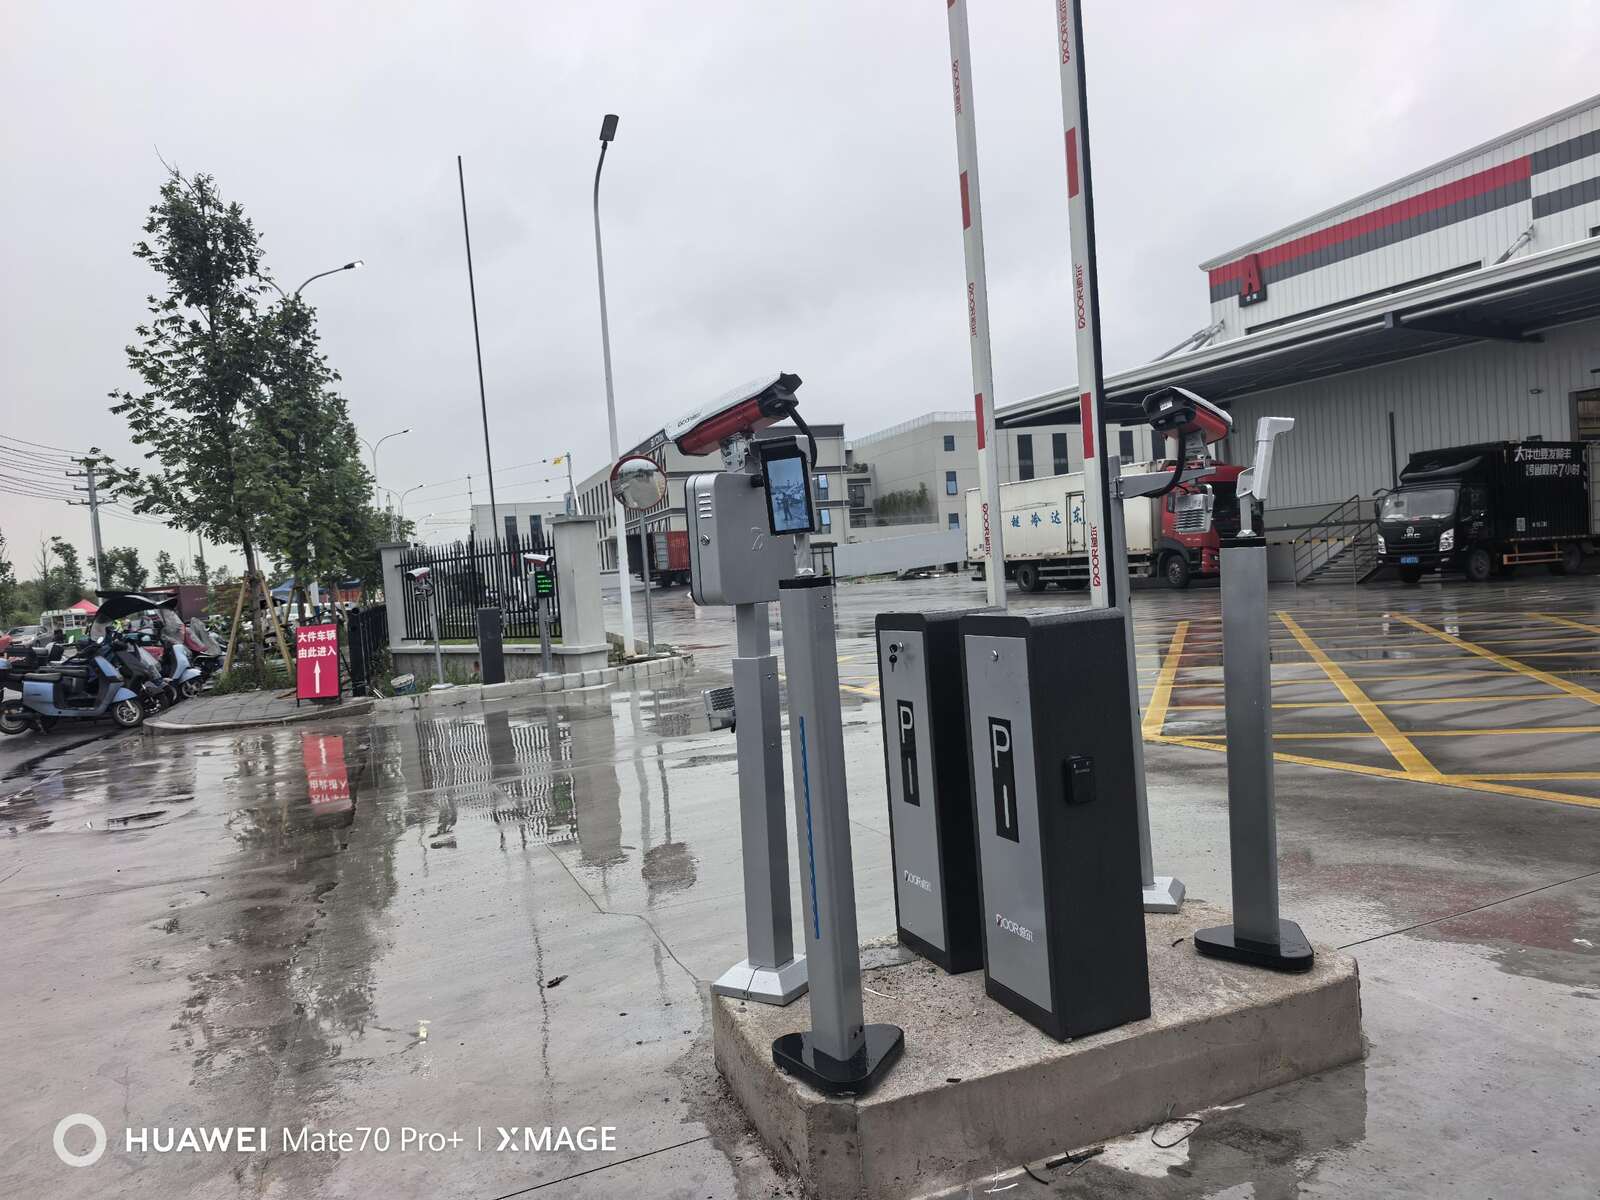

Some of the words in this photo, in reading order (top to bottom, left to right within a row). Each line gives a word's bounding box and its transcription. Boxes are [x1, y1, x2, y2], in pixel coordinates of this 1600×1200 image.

[298, 629, 337, 643] 大件车辆
[298, 645, 337, 659] 由此进入
[900, 705, 913, 744] P
[991, 723, 1010, 768] P
